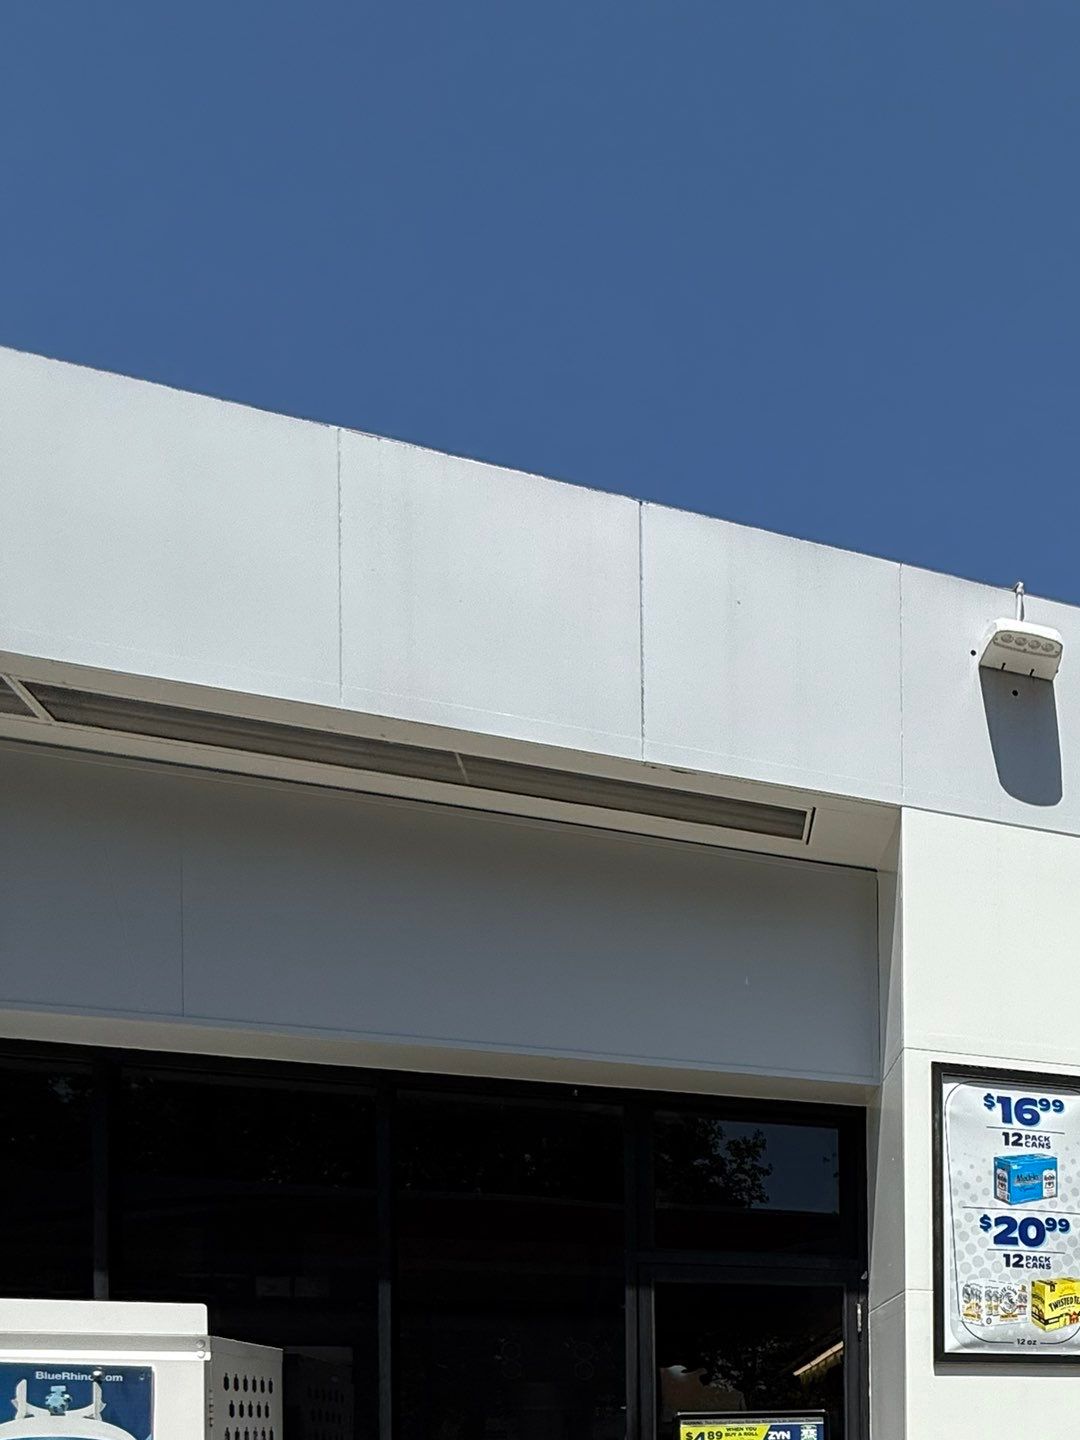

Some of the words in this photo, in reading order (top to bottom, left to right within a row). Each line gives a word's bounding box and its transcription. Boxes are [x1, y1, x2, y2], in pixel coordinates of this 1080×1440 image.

[1002, 1132, 1023, 1147] 12
[1025, 1141, 1051, 1149] CANS
[1003, 1254, 1024, 1268] 12
[1025, 1262, 1051, 1270] CANS
[1049, 1298, 1073, 1311] TWISTED
[768, 1431, 790, 1440] ZYN
